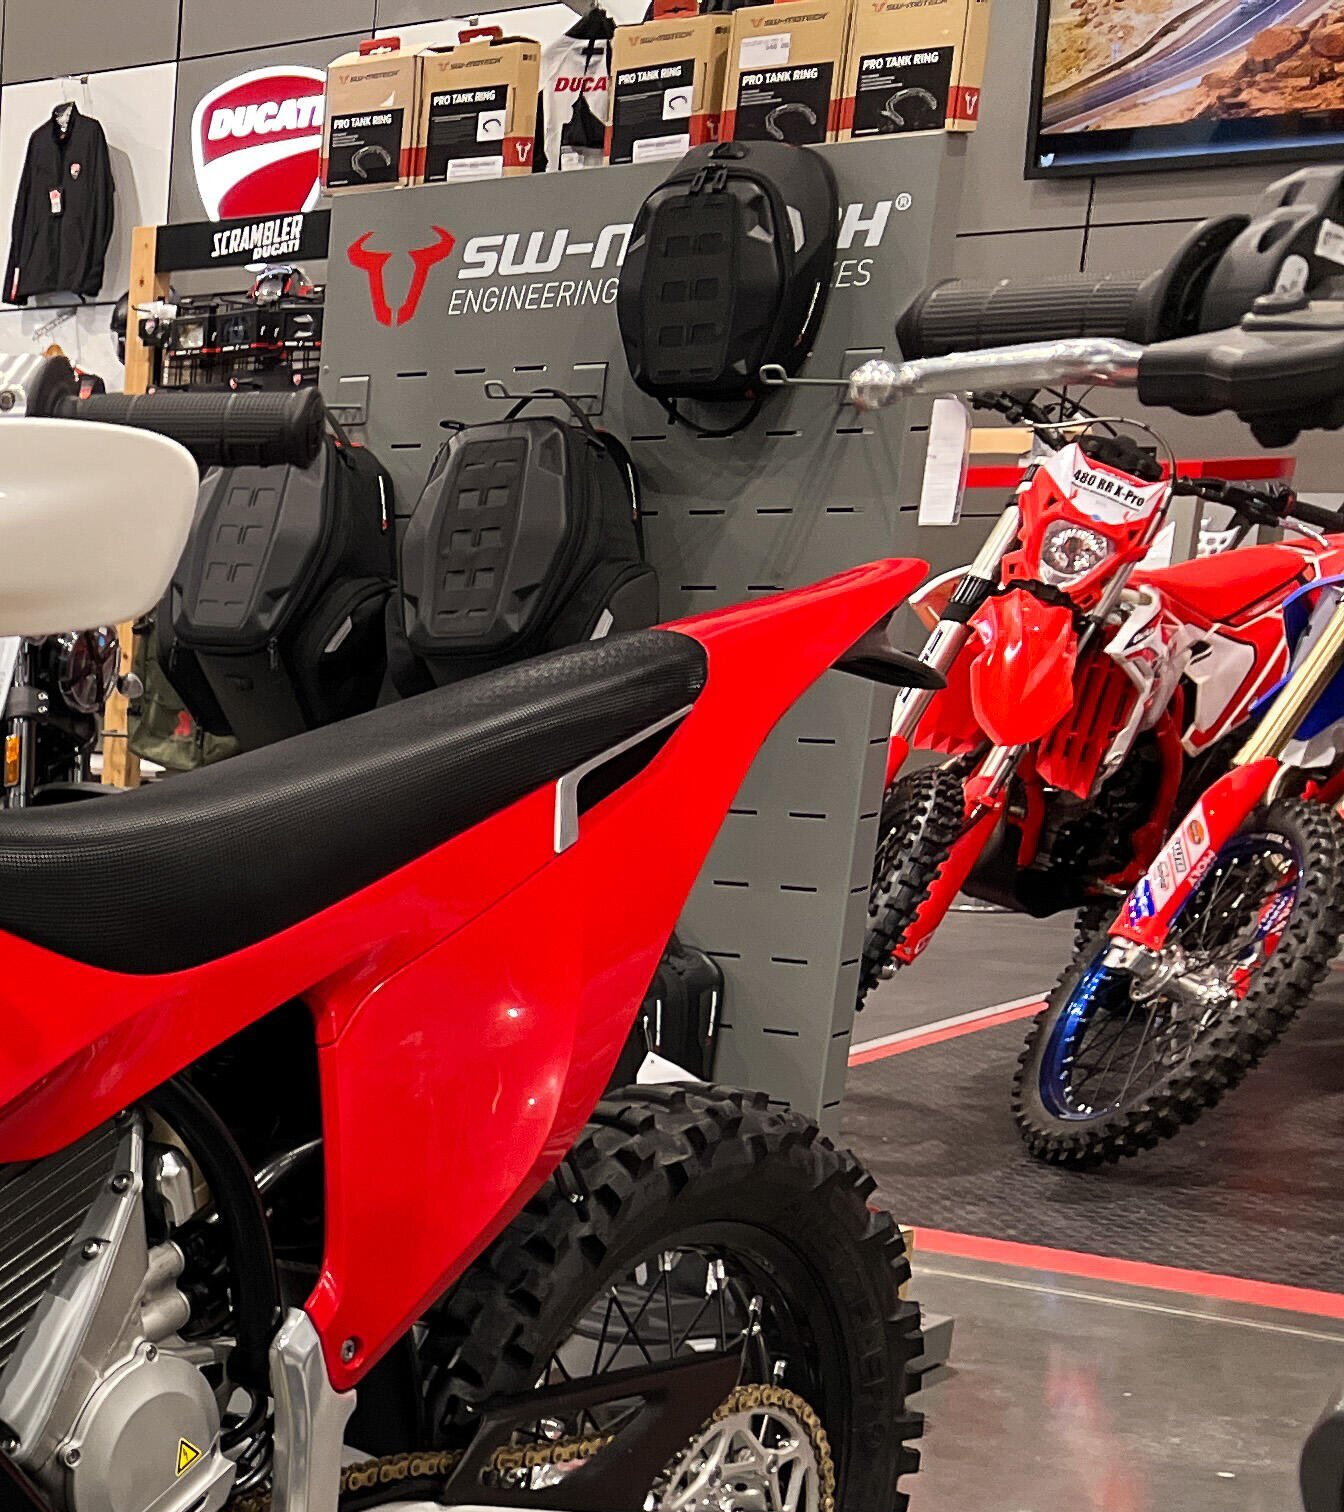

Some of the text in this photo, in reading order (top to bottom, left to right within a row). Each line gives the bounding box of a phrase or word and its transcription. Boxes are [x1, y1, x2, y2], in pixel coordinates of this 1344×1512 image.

[862, 52, 939, 71] PRO TANK RING
[618, 66, 682, 85] PRO TANK RING
[742, 68, 818, 87] PRO TANK RING
[433, 90, 496, 106] PRO TANK RING
[208, 94, 325, 140] DUCATI
[334, 113, 392, 130] PRO TANK RING
[211, 215, 303, 258] SCRAMBLER
[253, 239, 300, 260] DUCATI
[448, 278, 620, 316] ENGINEERING
[1073, 469, 1145, 507] 480 RR X-Pro
